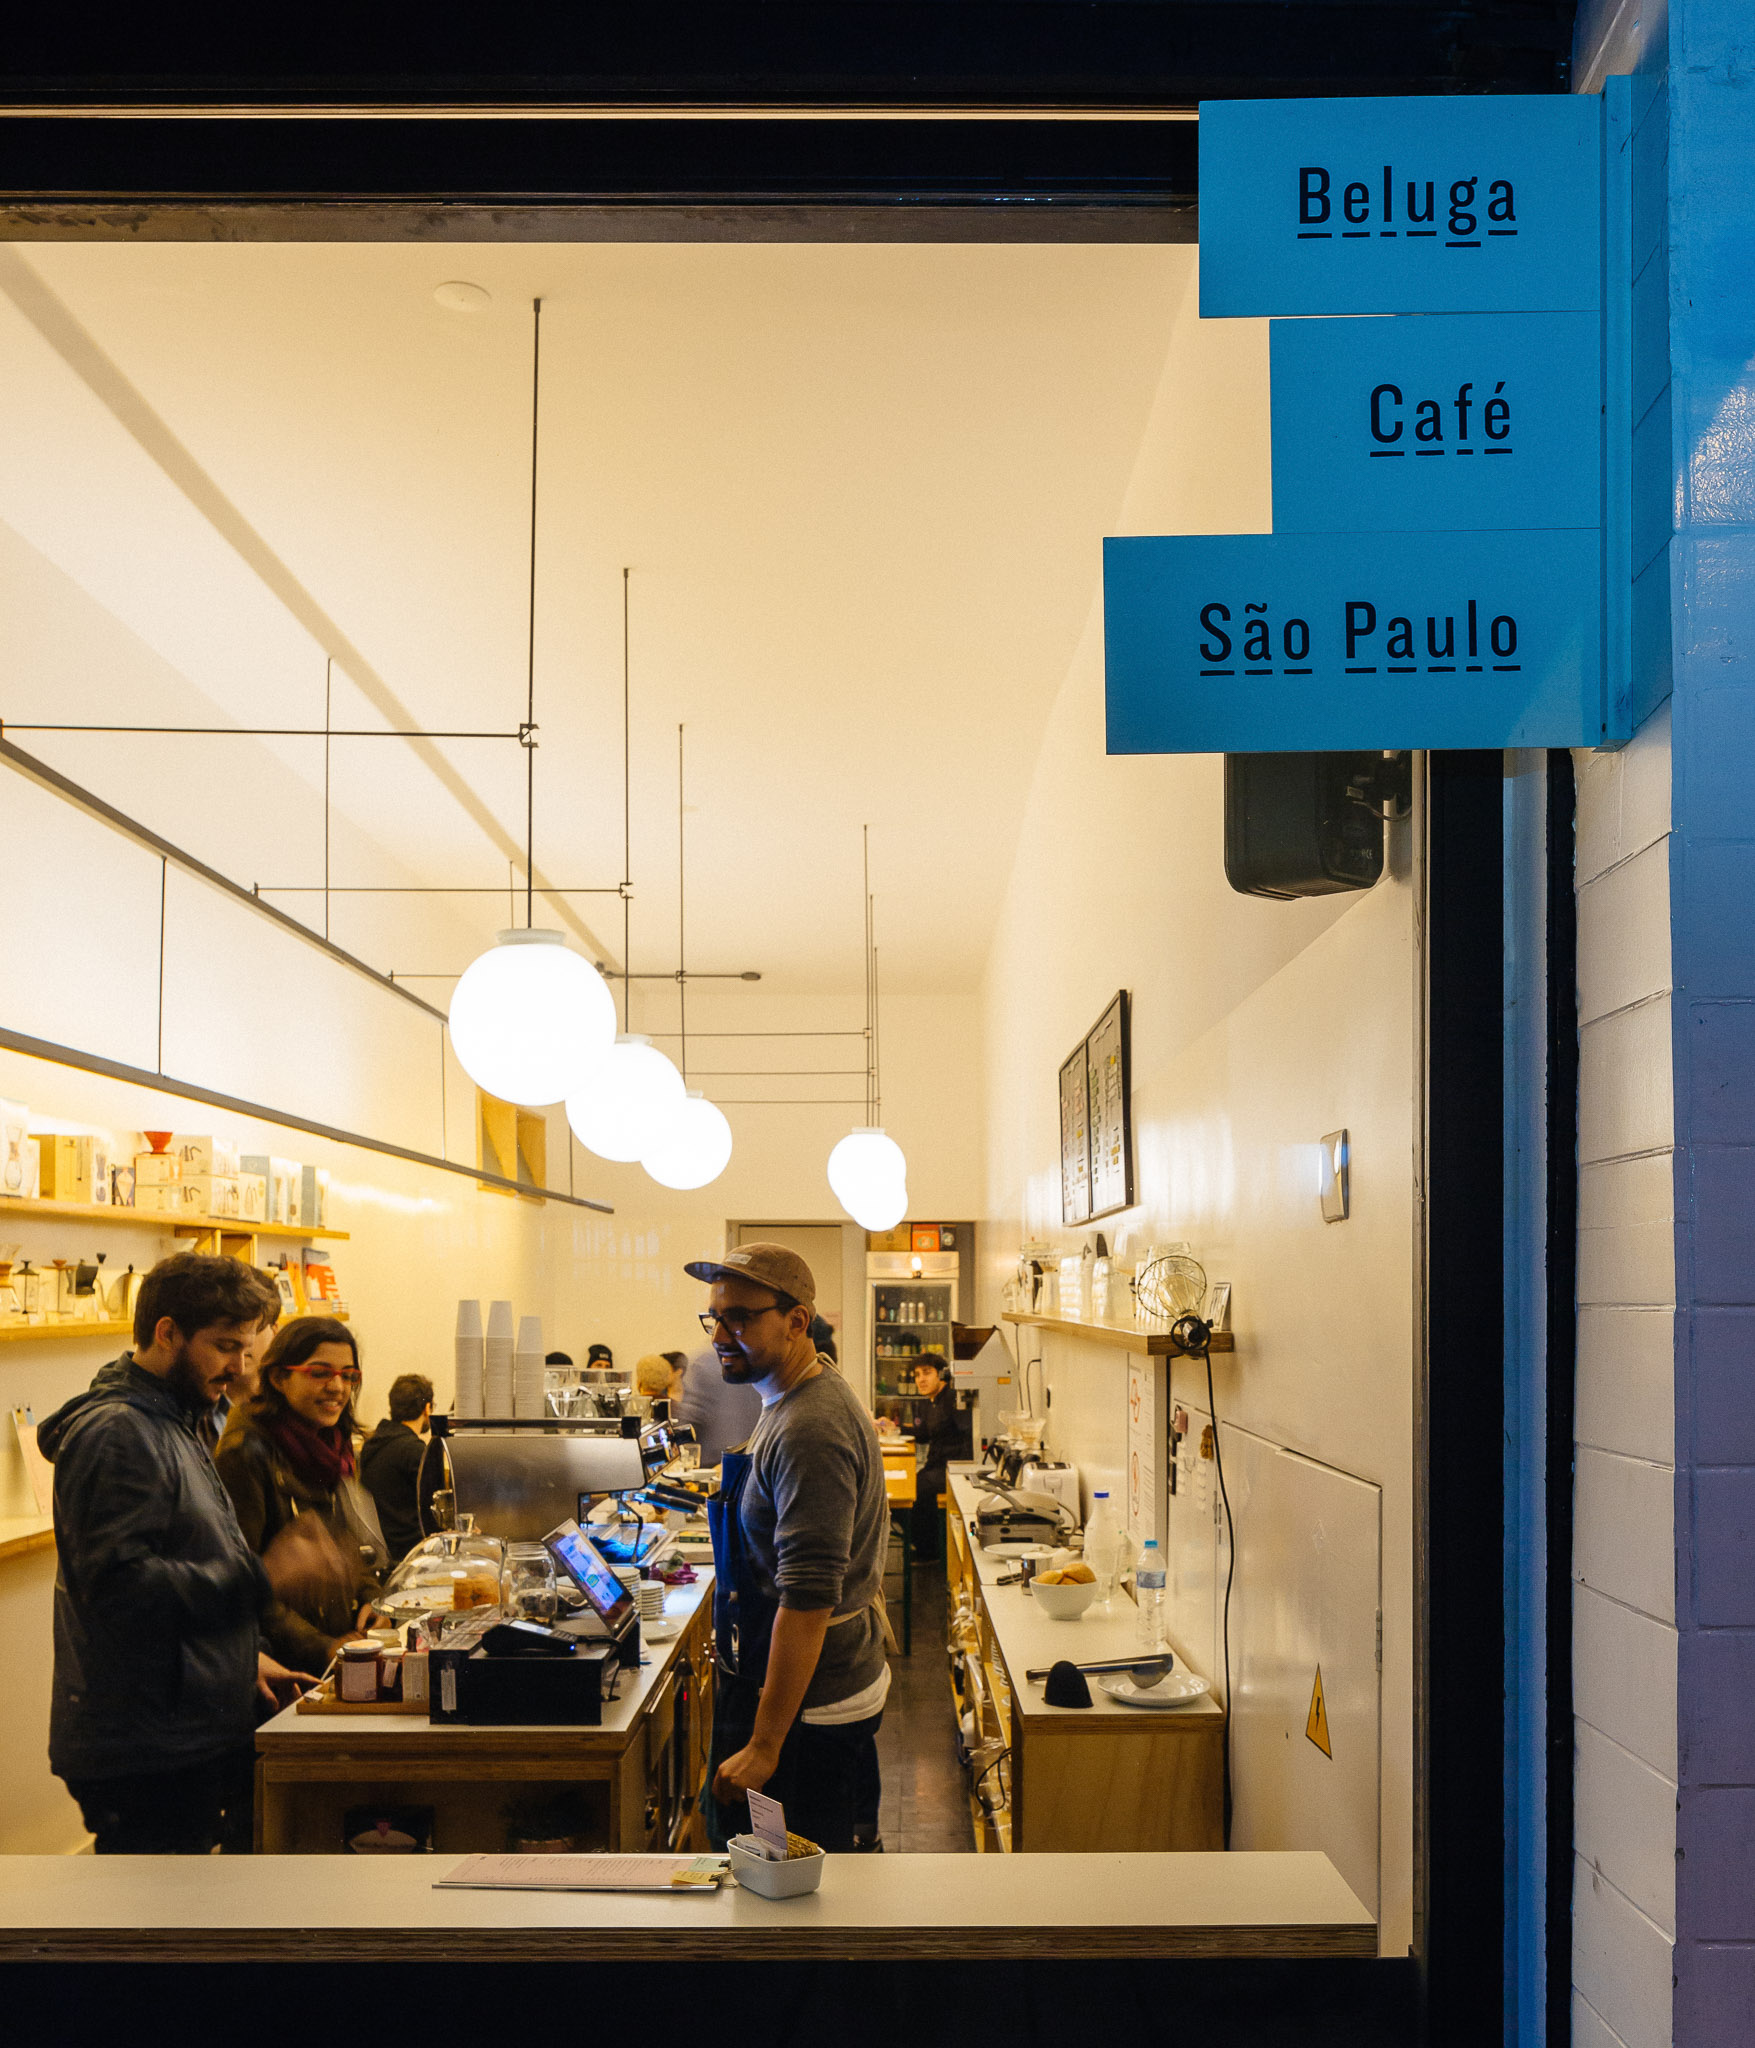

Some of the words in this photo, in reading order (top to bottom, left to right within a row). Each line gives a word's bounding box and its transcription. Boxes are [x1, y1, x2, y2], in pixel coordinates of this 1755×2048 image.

[1298, 165, 1516, 236] Beluga
[1370, 381, 1511, 443] Café
[1200, 602, 1311, 662] São
[1345, 599, 1518, 658] Paulo
